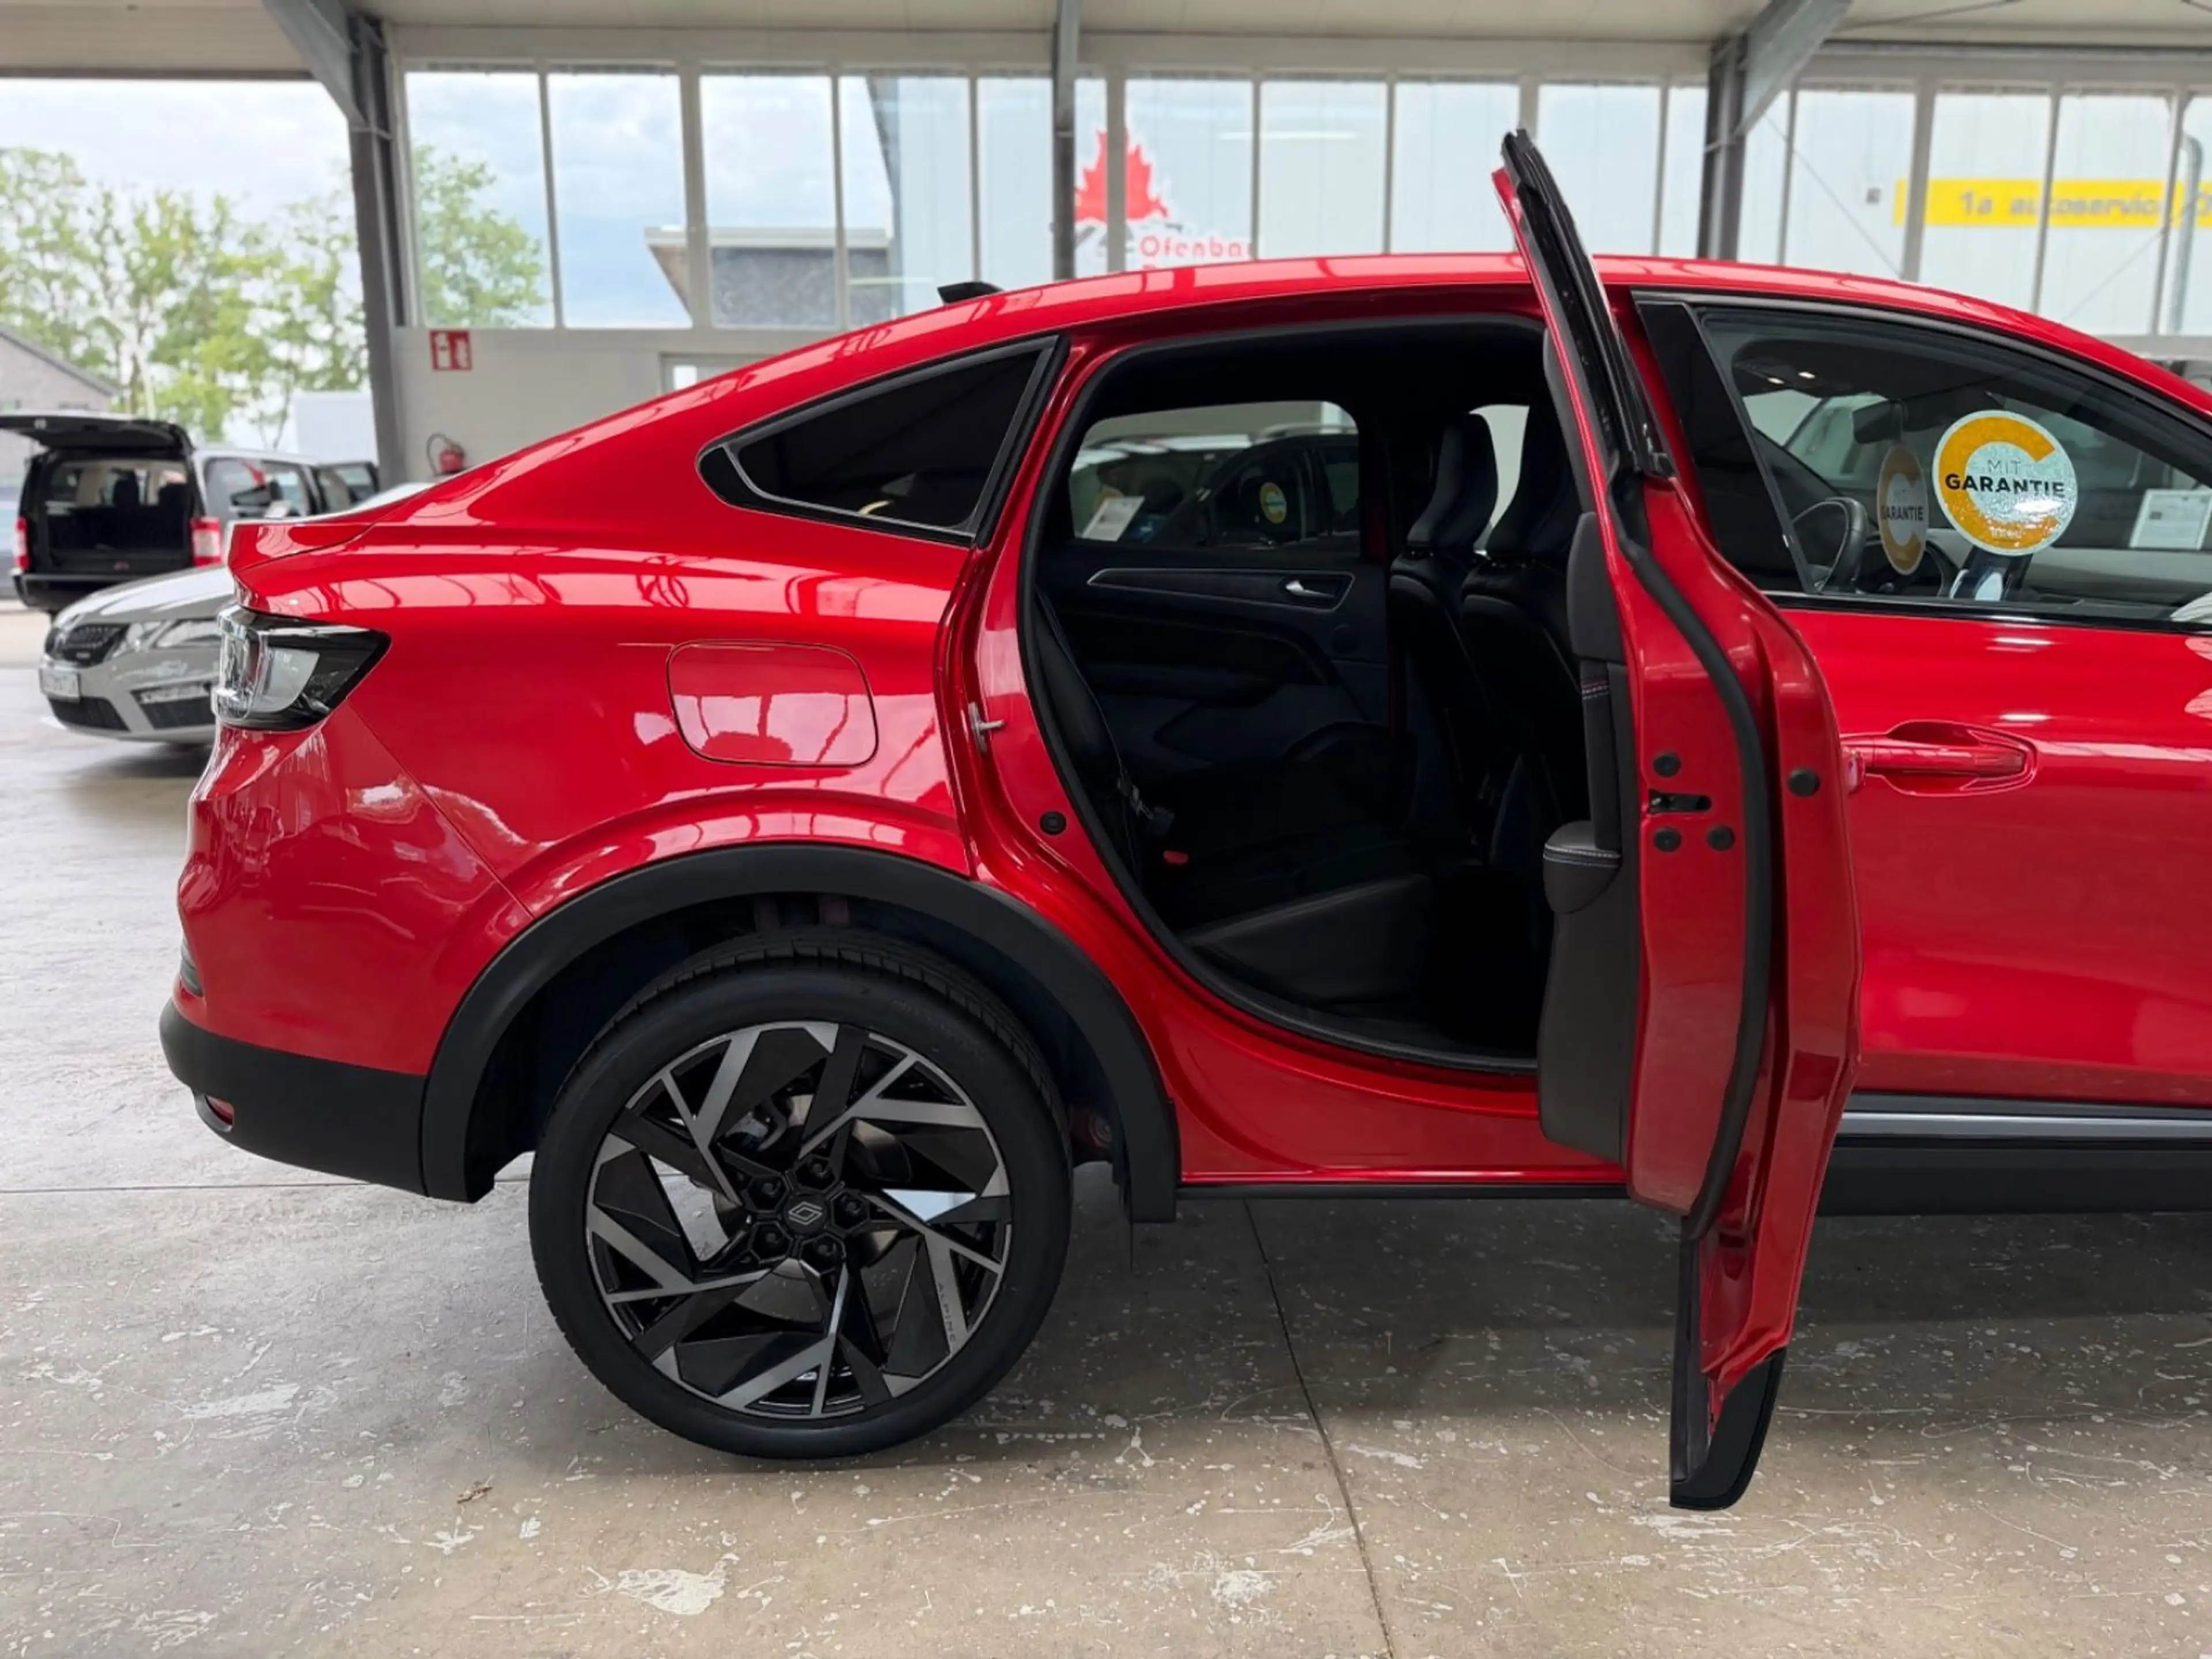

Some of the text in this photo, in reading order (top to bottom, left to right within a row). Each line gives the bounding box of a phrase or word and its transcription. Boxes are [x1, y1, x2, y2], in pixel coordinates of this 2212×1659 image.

[1960, 190, 1993, 215] 1a
[1988, 459, 2021, 475] MIT
[1945, 473, 2065, 498] GARANTIE
